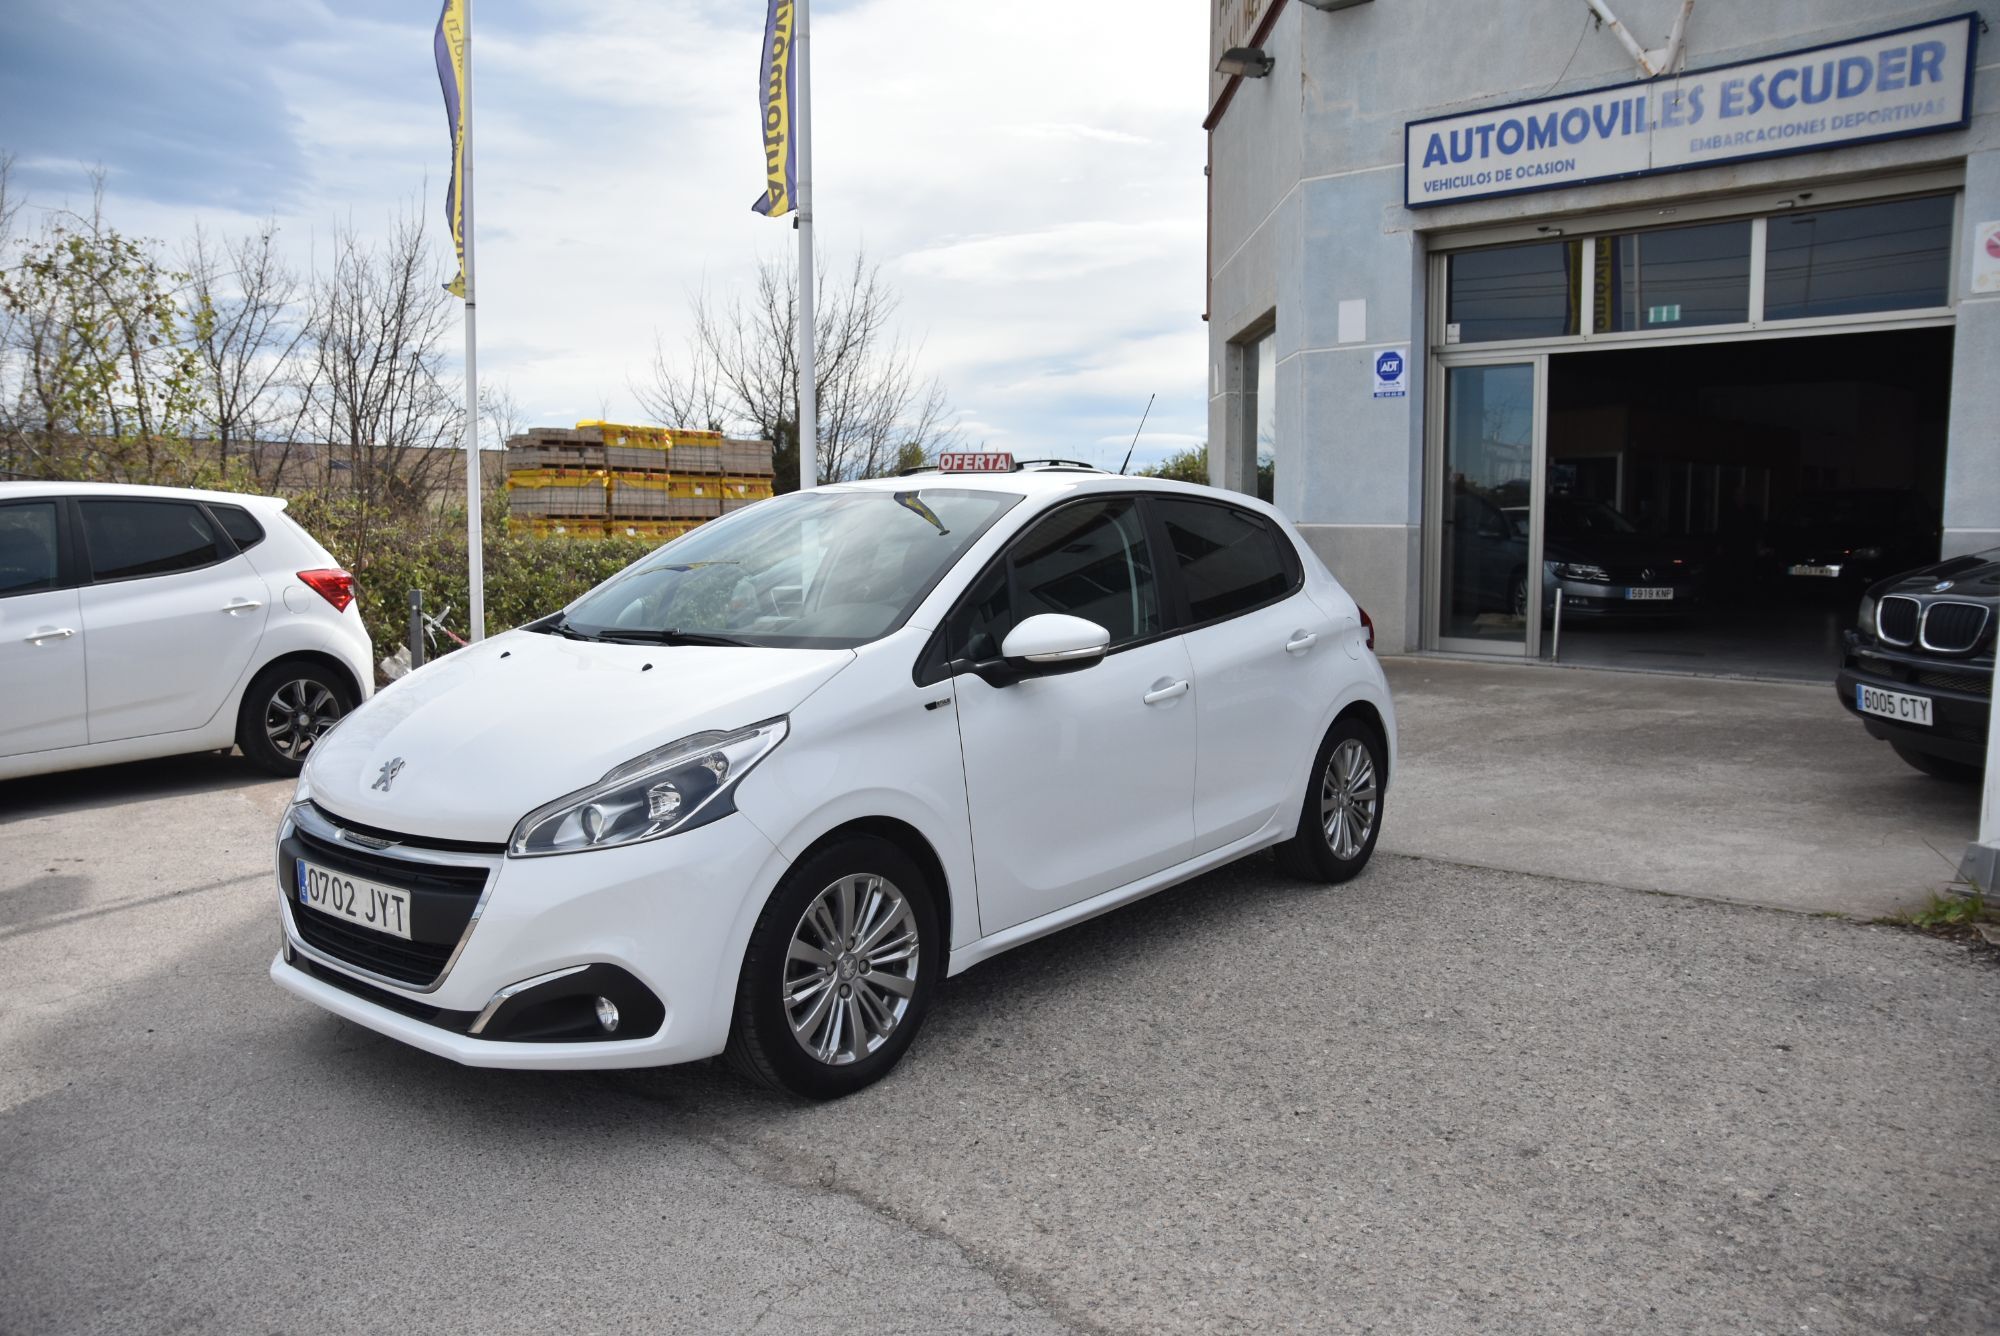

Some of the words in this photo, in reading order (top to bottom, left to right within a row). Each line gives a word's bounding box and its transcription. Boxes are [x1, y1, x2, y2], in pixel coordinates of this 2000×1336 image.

[1422, 84, 1705, 168] AUTOMOVILES
[1718, 40, 1947, 119] ESCUDER
[1690, 119, 1826, 153] EMBARCACIONES
[1831, 97, 1946, 131] DEPORTIVAS
[1424, 170, 1492, 193] VEHICULOS
[1495, 167, 1512, 182] DE
[1515, 158, 1575, 179] OCASION
[1380, 360, 1399, 372] ADT
[940, 454, 1008, 470] OFERTA
[1864, 689, 1895, 714] 6005
[1900, 697, 1928, 721] CTY
[308, 868, 357, 917] 0702
[365, 888, 404, 932] JYT
